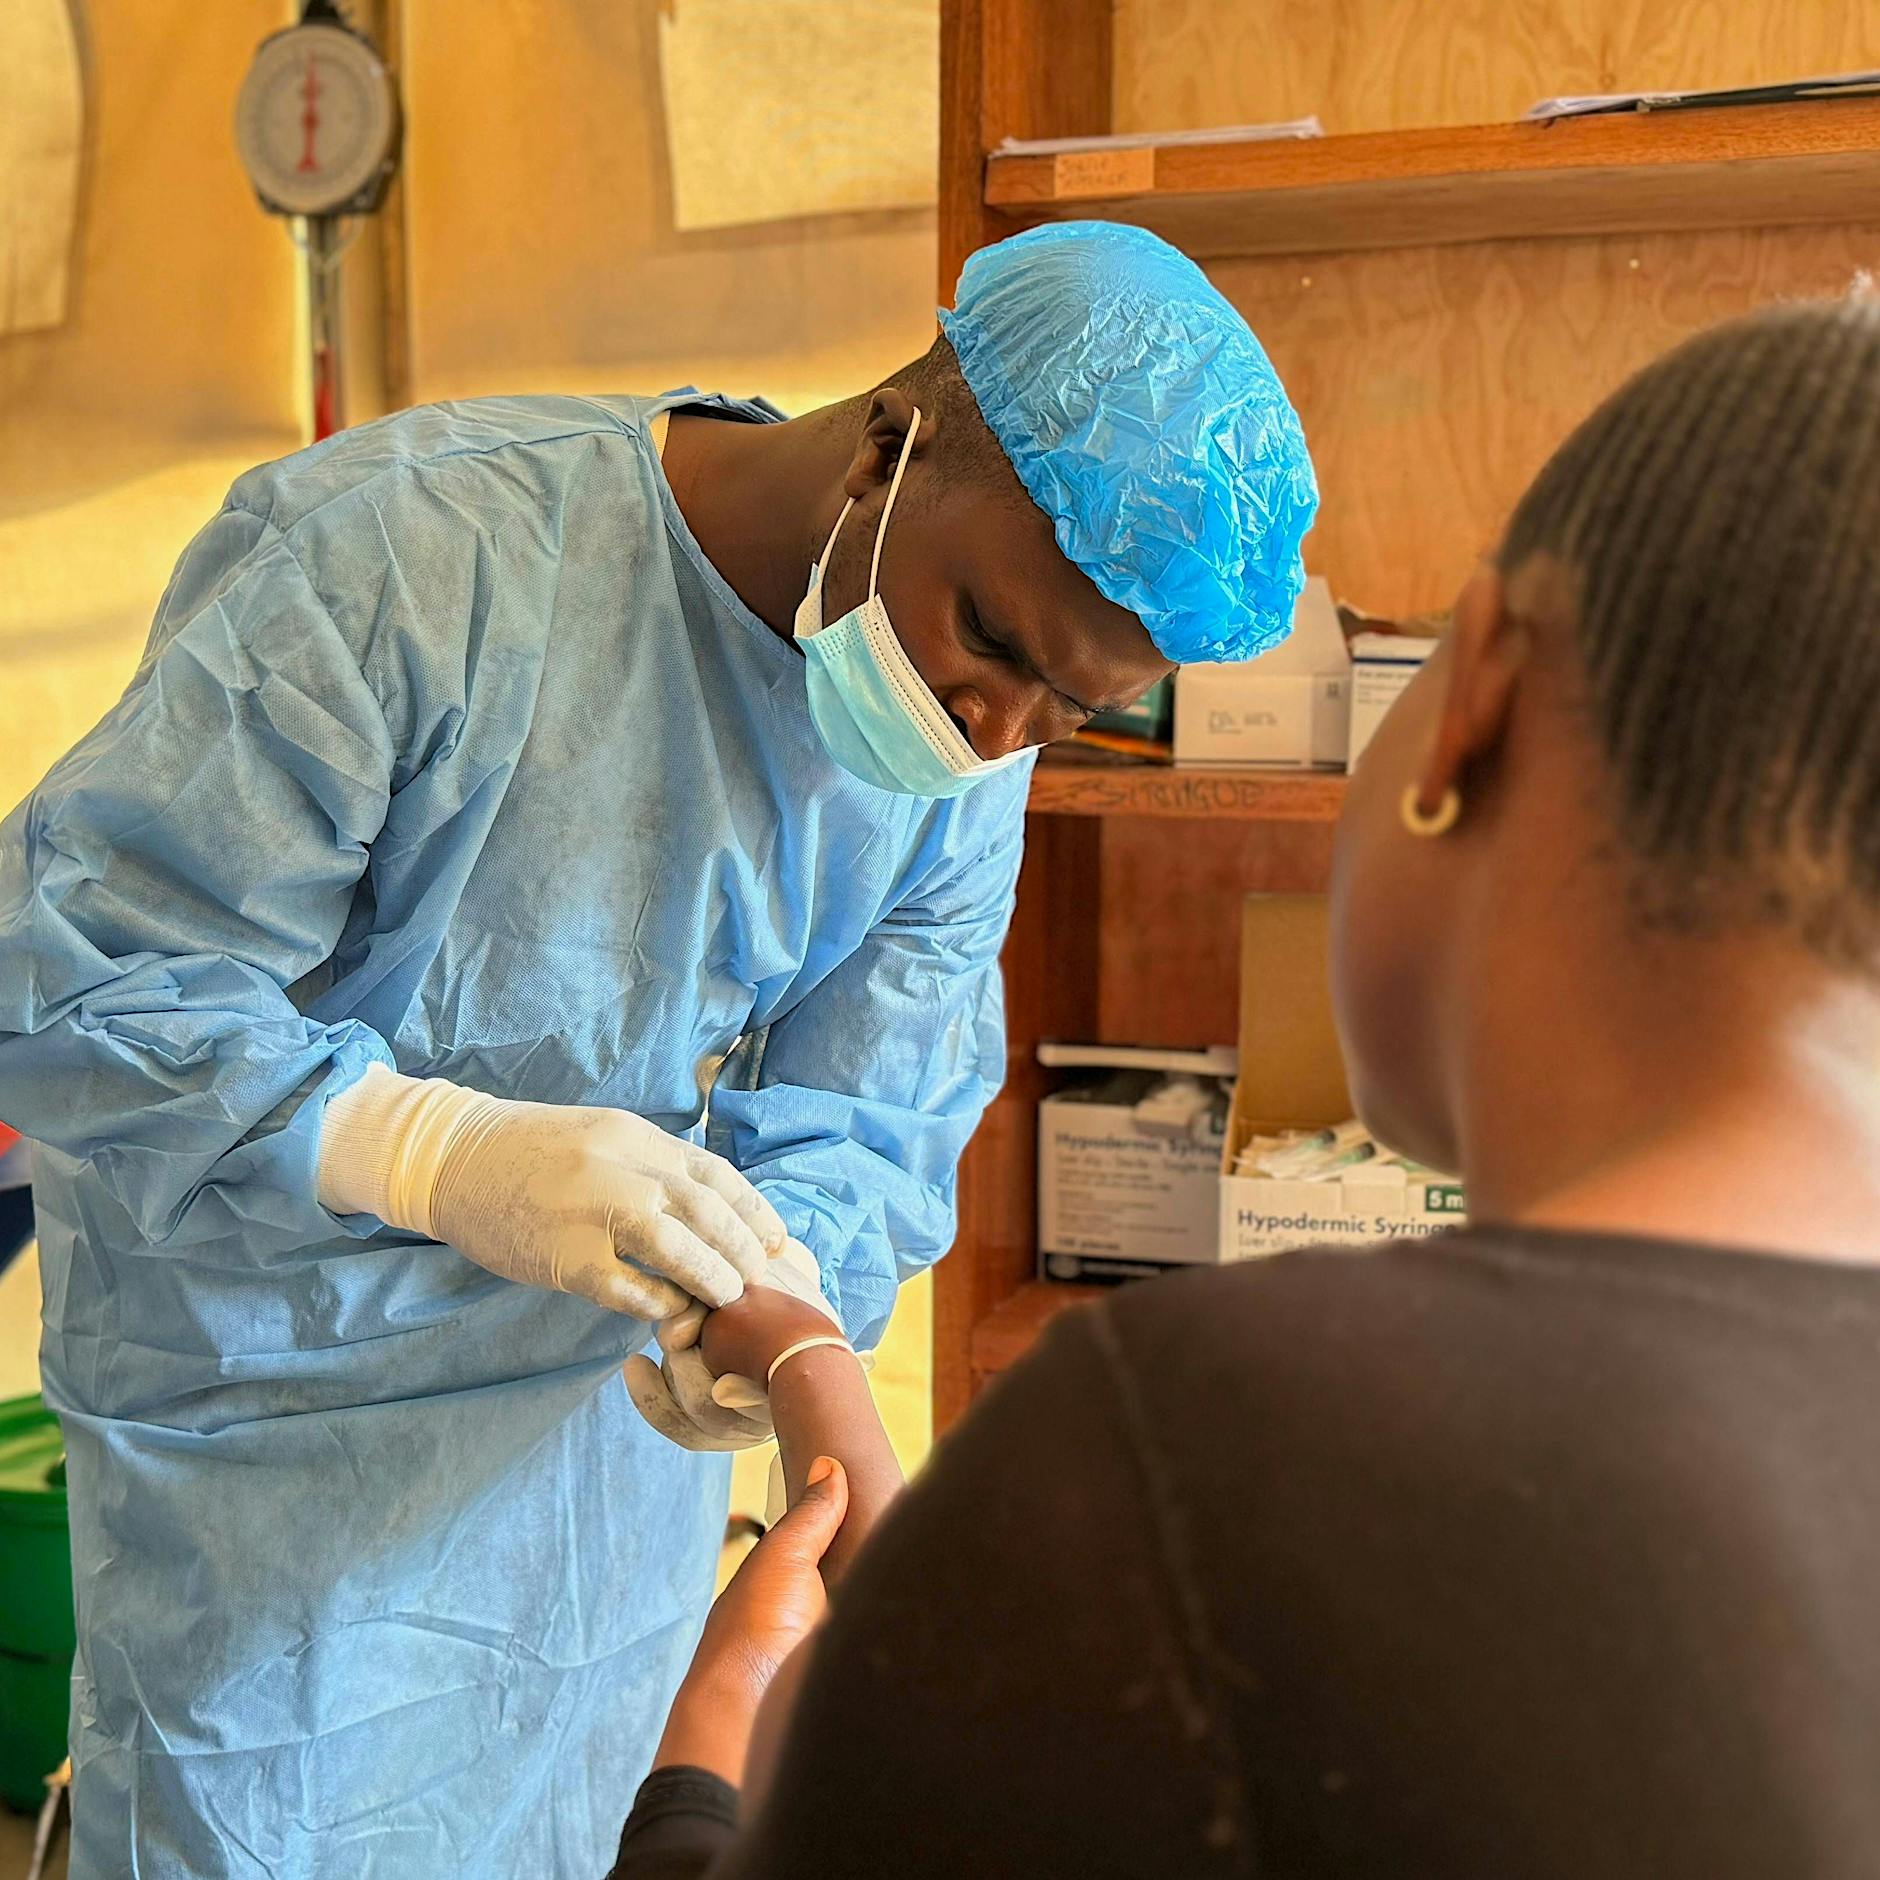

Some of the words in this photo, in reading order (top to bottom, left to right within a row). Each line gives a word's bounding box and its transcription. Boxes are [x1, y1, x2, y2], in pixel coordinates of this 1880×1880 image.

[1428, 1189, 1443, 1209] 5
[1445, 1193, 1465, 1210] m
[1237, 1207, 1367, 1234] Hypodermic
